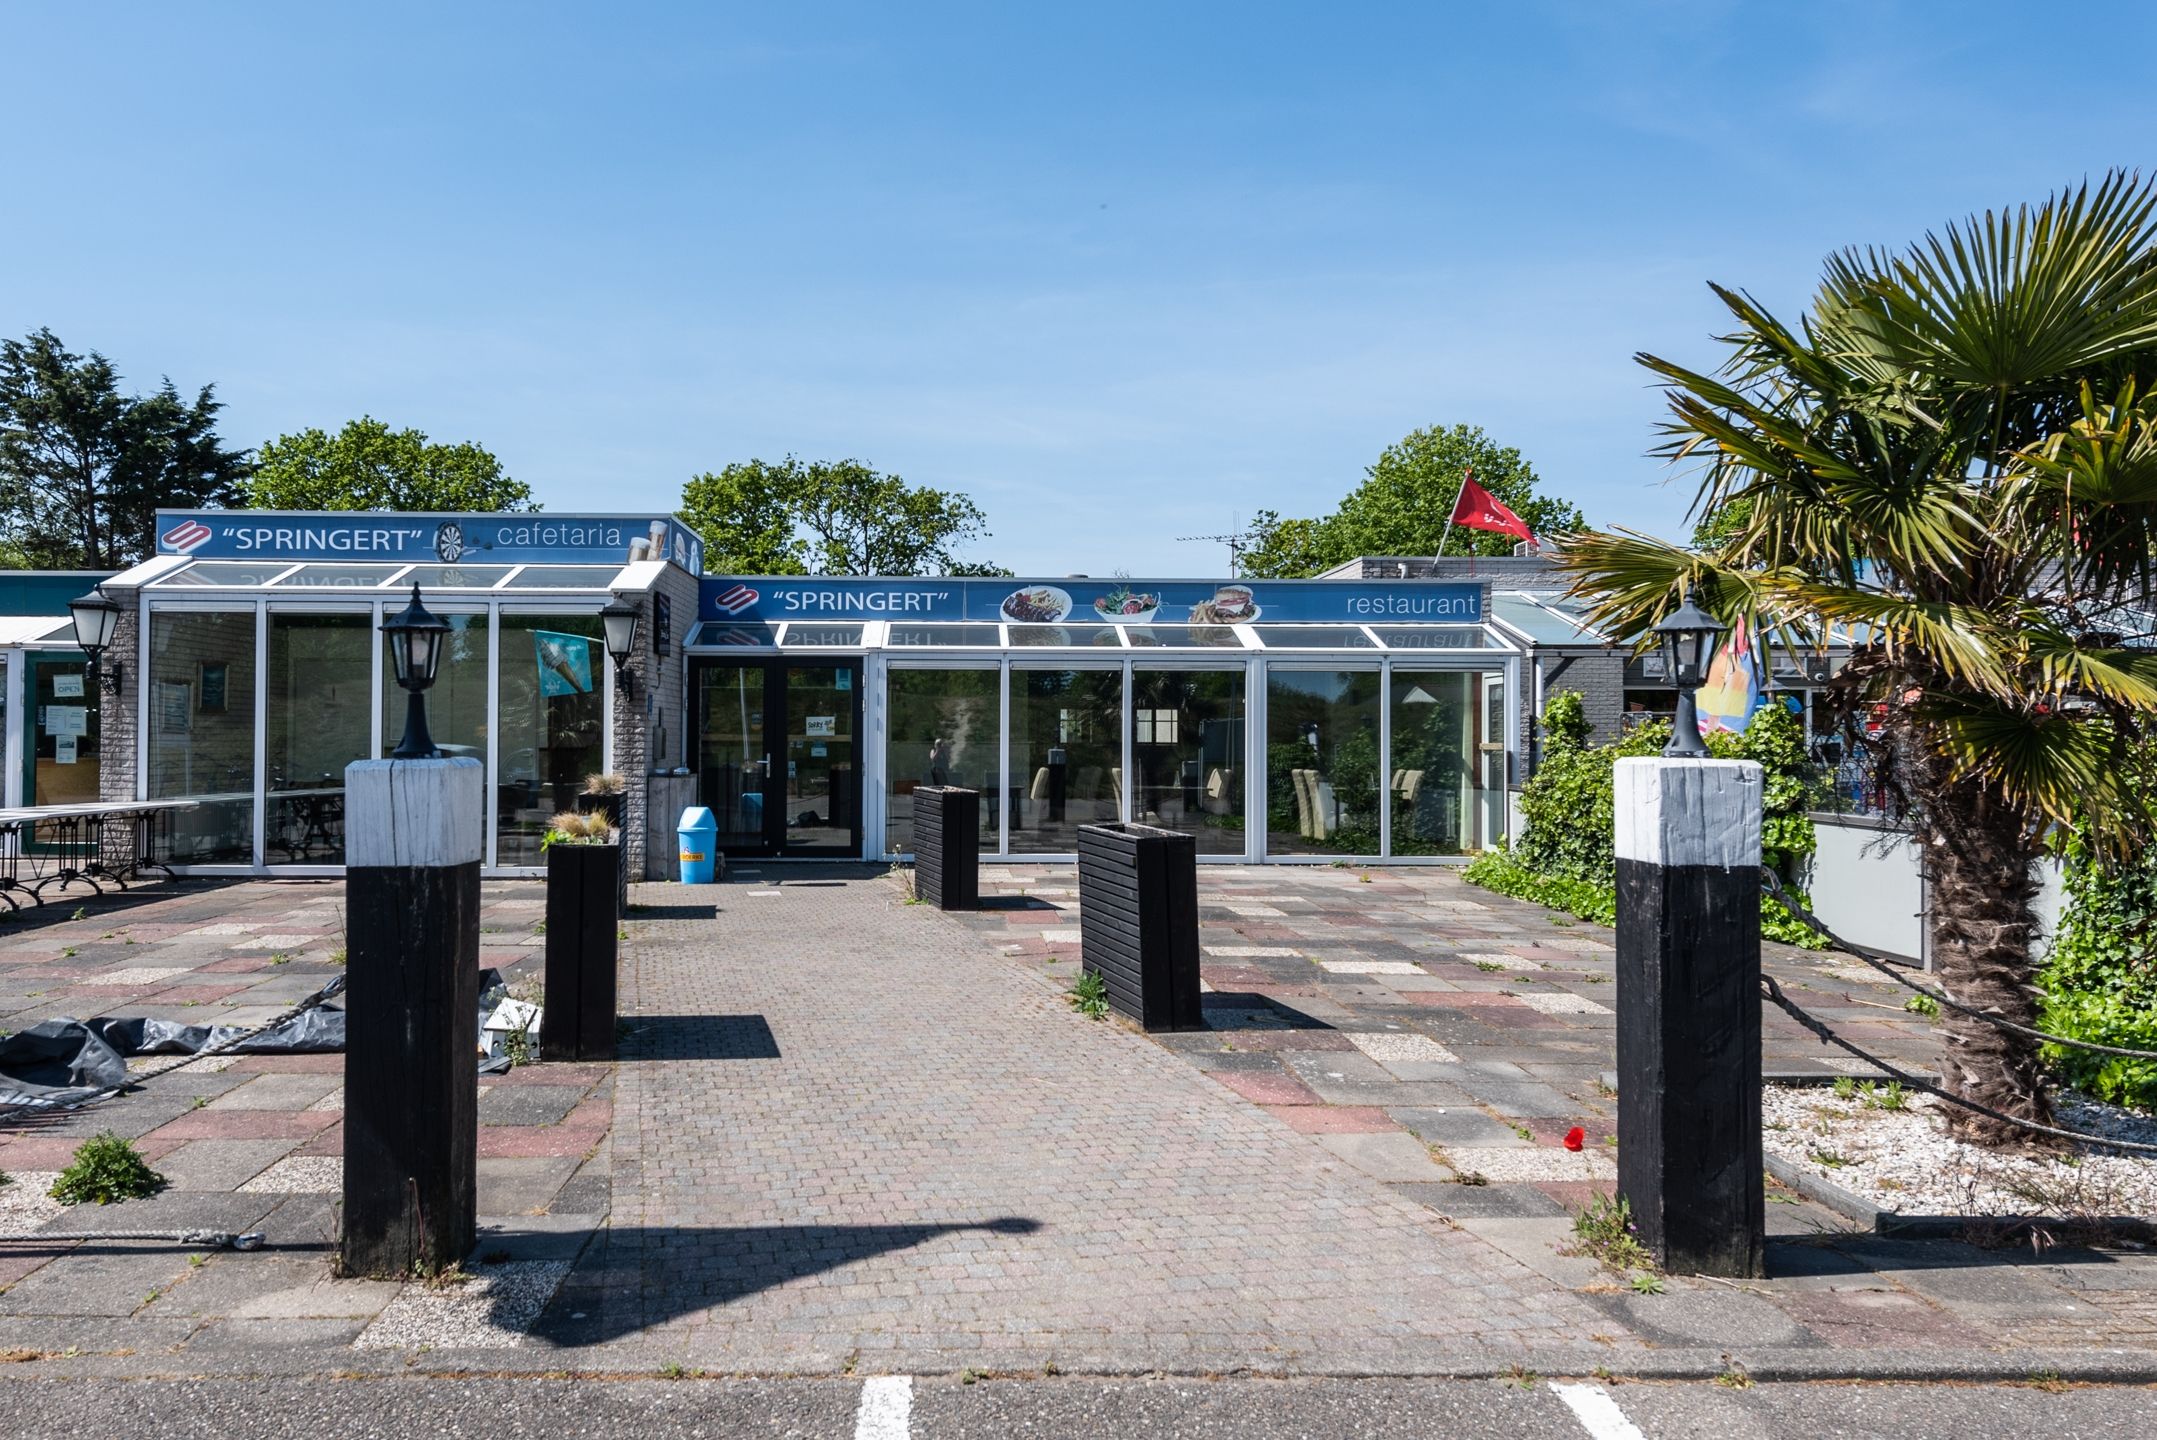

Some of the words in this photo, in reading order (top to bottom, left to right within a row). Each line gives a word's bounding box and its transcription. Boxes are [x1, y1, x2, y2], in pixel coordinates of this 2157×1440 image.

[222, 527, 423, 550] “SPRINGERT”
[497, 522, 622, 546] cafetaria
[773, 591, 949, 612] “SPRINGERT”
[1347, 594, 1476, 614] restaurant
[58, 685, 80, 693] OPEN
